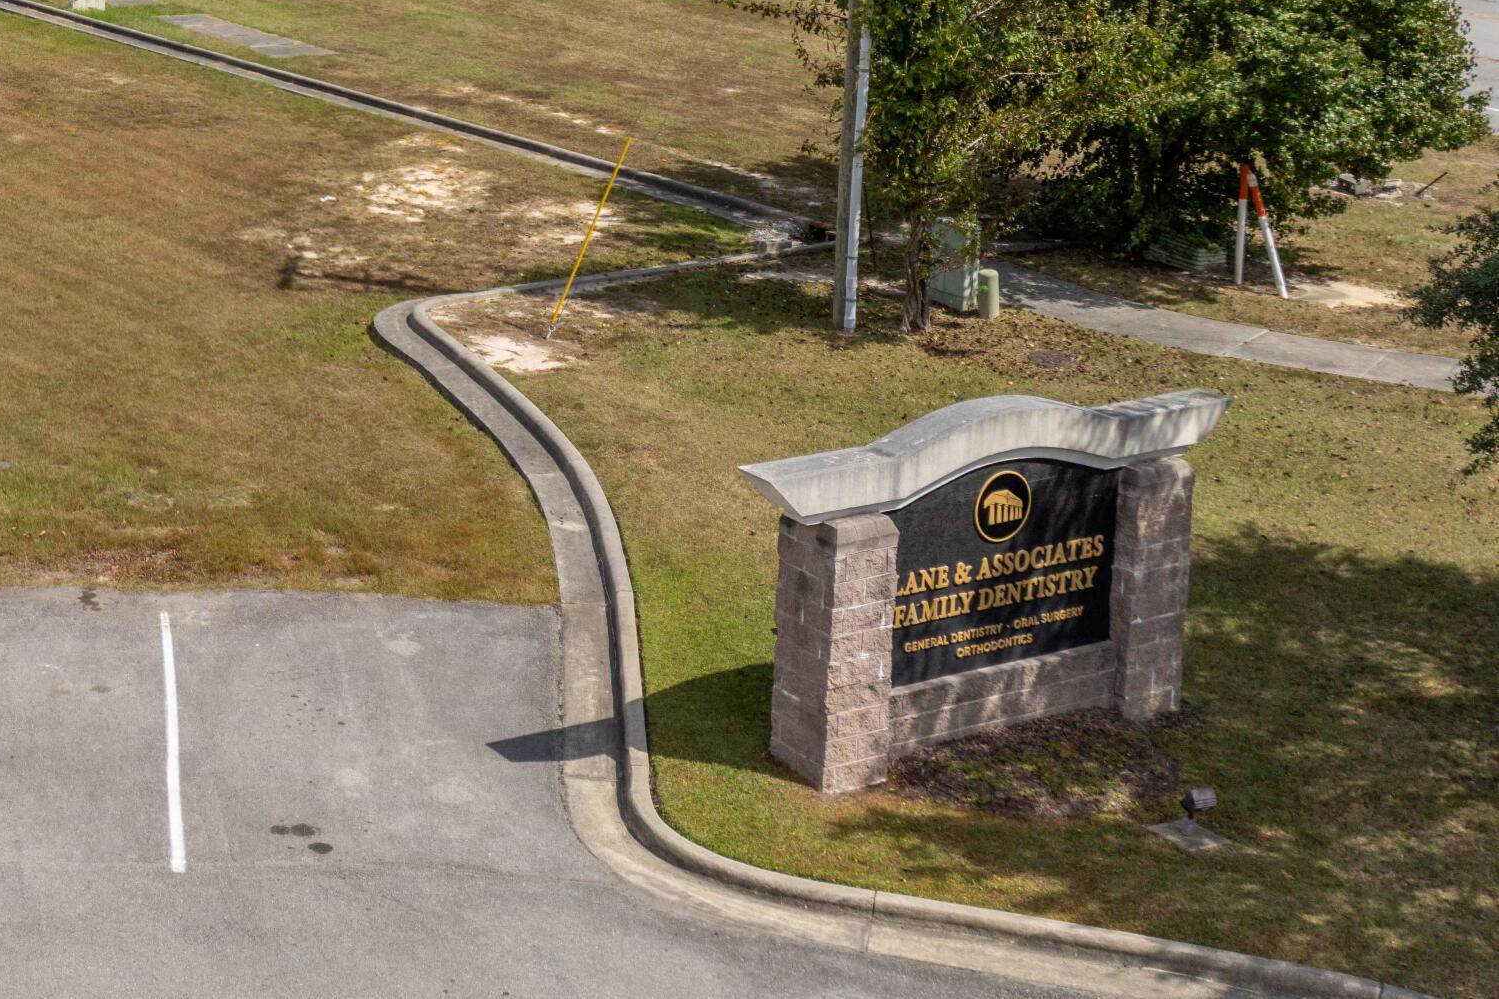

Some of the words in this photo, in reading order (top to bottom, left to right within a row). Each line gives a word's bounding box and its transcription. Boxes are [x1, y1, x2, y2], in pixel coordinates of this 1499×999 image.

[954, 561, 973, 586] &
[976, 534, 1105, 581] ASSOCIATES
[893, 590, 976, 630] FAMILY
[977, 565, 1099, 611] DENTISTRY
[904, 635, 950, 654] GENERAL
[951, 622, 1004, 643] DENTISTRY
[1013, 616, 1040, 630] ORAL
[1041, 605, 1085, 625] SURGERY
[956, 633, 1034, 659] ORTHODONTICS
